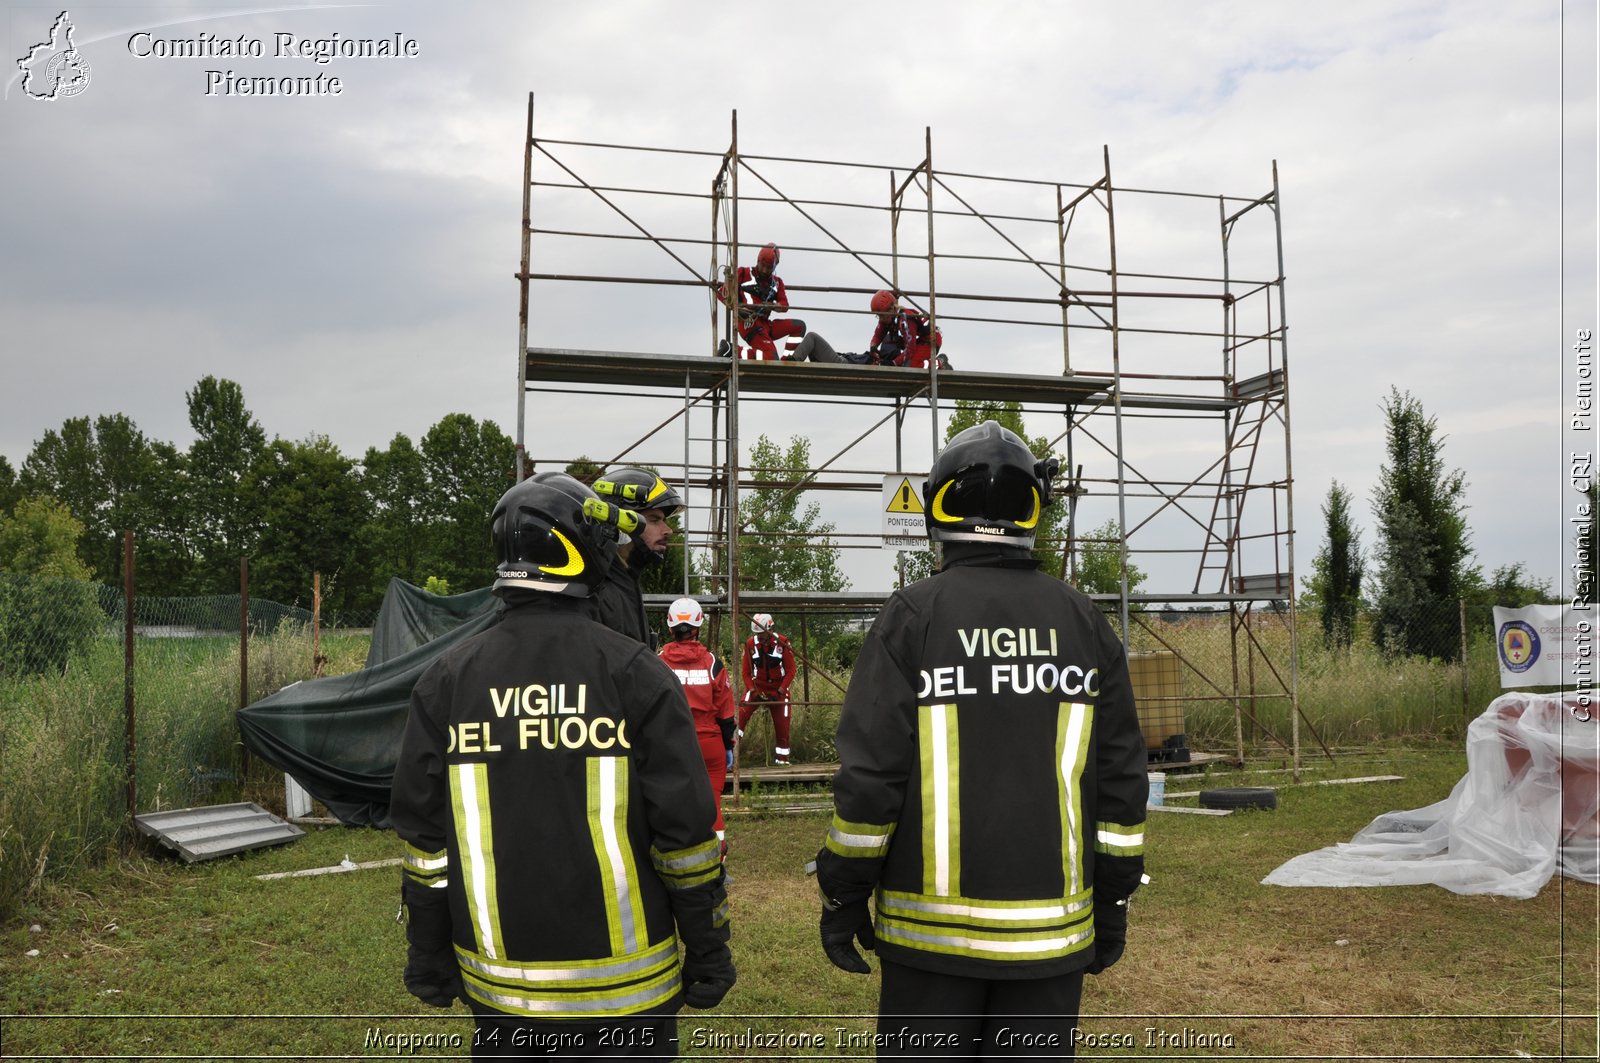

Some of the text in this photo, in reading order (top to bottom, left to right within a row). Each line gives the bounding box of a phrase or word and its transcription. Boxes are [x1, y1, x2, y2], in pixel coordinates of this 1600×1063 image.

[888, 518, 925, 527] PONTEGGIO
[974, 525, 1005, 535] DANIELE
[885, 537, 928, 547] ALLESTIMENTO
[957, 627, 1059, 658] VIGILI
[489, 683, 587, 718] VIGILI
